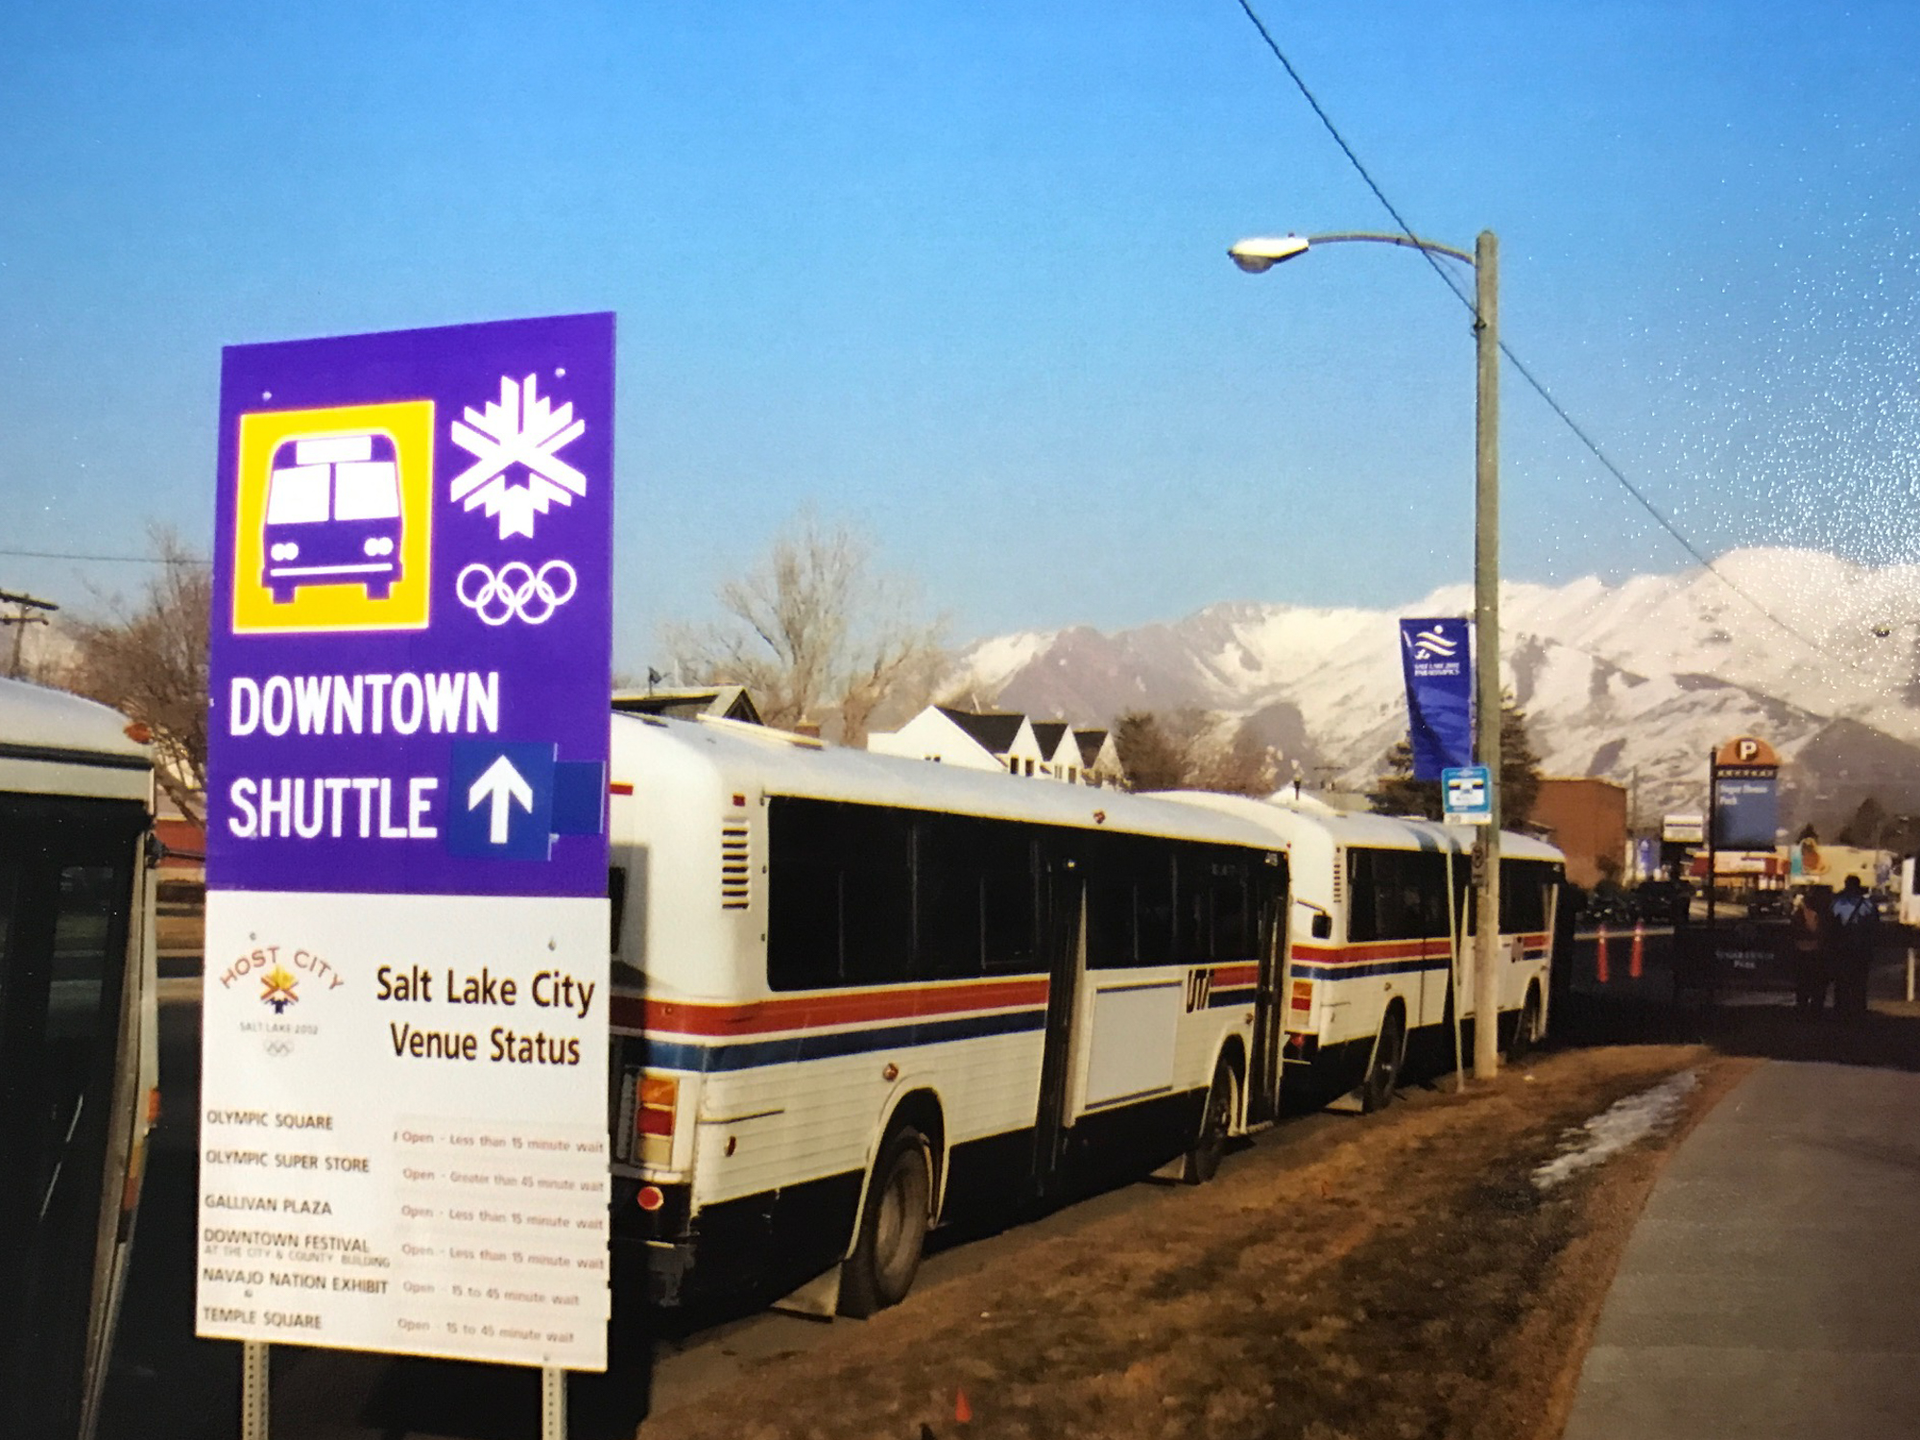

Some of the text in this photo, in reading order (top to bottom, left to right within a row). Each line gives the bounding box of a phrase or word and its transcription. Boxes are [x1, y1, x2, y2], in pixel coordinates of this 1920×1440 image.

[229, 671, 500, 737] DOWNTOWN
[1740, 741, 1757, 760] P
[228, 777, 439, 839] SHUTTLE
[220, 946, 345, 990] HOST CITY
[376, 964, 596, 1019] Salt Lake City
[266, 1023, 291, 1033] LAKE
[390, 1022, 581, 1066] Venue Status
[206, 1110, 333, 1130] OLYMPIC SQUARE
[402, 1131, 434, 1145] Open
[449, 1134, 474, 1146] Less
[480, 1136, 506, 1147] than
[512, 1138, 522, 1149] 15
[528, 1139, 570, 1151] minute
[576, 1142, 604, 1152] wait
[206, 1150, 370, 1173] OLYMPIC SUPER STORE
[403, 1168, 435, 1182] Open
[450, 1171, 489, 1184] Greater
[494, 1173, 517, 1186] than
[521, 1176, 534, 1188] 45
[538, 1177, 575, 1190] minute
[580, 1180, 604, 1191] wait
[205, 1194, 332, 1215] GALLIVAN PLAZA
[401, 1205, 433, 1219] Open
[449, 1208, 474, 1221] Less
[479, 1210, 506, 1222] than
[512, 1213, 522, 1224] 15
[527, 1214, 570, 1228] minute
[576, 1219, 603, 1230] wait
[204, 1228, 369, 1253] DOWNTOWN FESTIVAL
[289, 1250, 333, 1263] COUNTY
[341, 1254, 391, 1268] BUILDING
[401, 1243, 434, 1257] Open
[450, 1247, 474, 1259] Less
[480, 1249, 507, 1261] than
[512, 1252, 523, 1263] 15
[528, 1254, 570, 1266] minute
[577, 1258, 604, 1270] wait
[203, 1267, 388, 1294] NAVAJO NATION EXHIBIT
[403, 1280, 580, 1306] Open 15 to 45 minute wait
[203, 1307, 322, 1329] TEMPLE SQUARE
[398, 1318, 430, 1332] Open
[447, 1321, 457, 1334] 15
[463, 1324, 476, 1335] to
[499, 1327, 541, 1341] minute
[546, 1331, 574, 1343] wait
